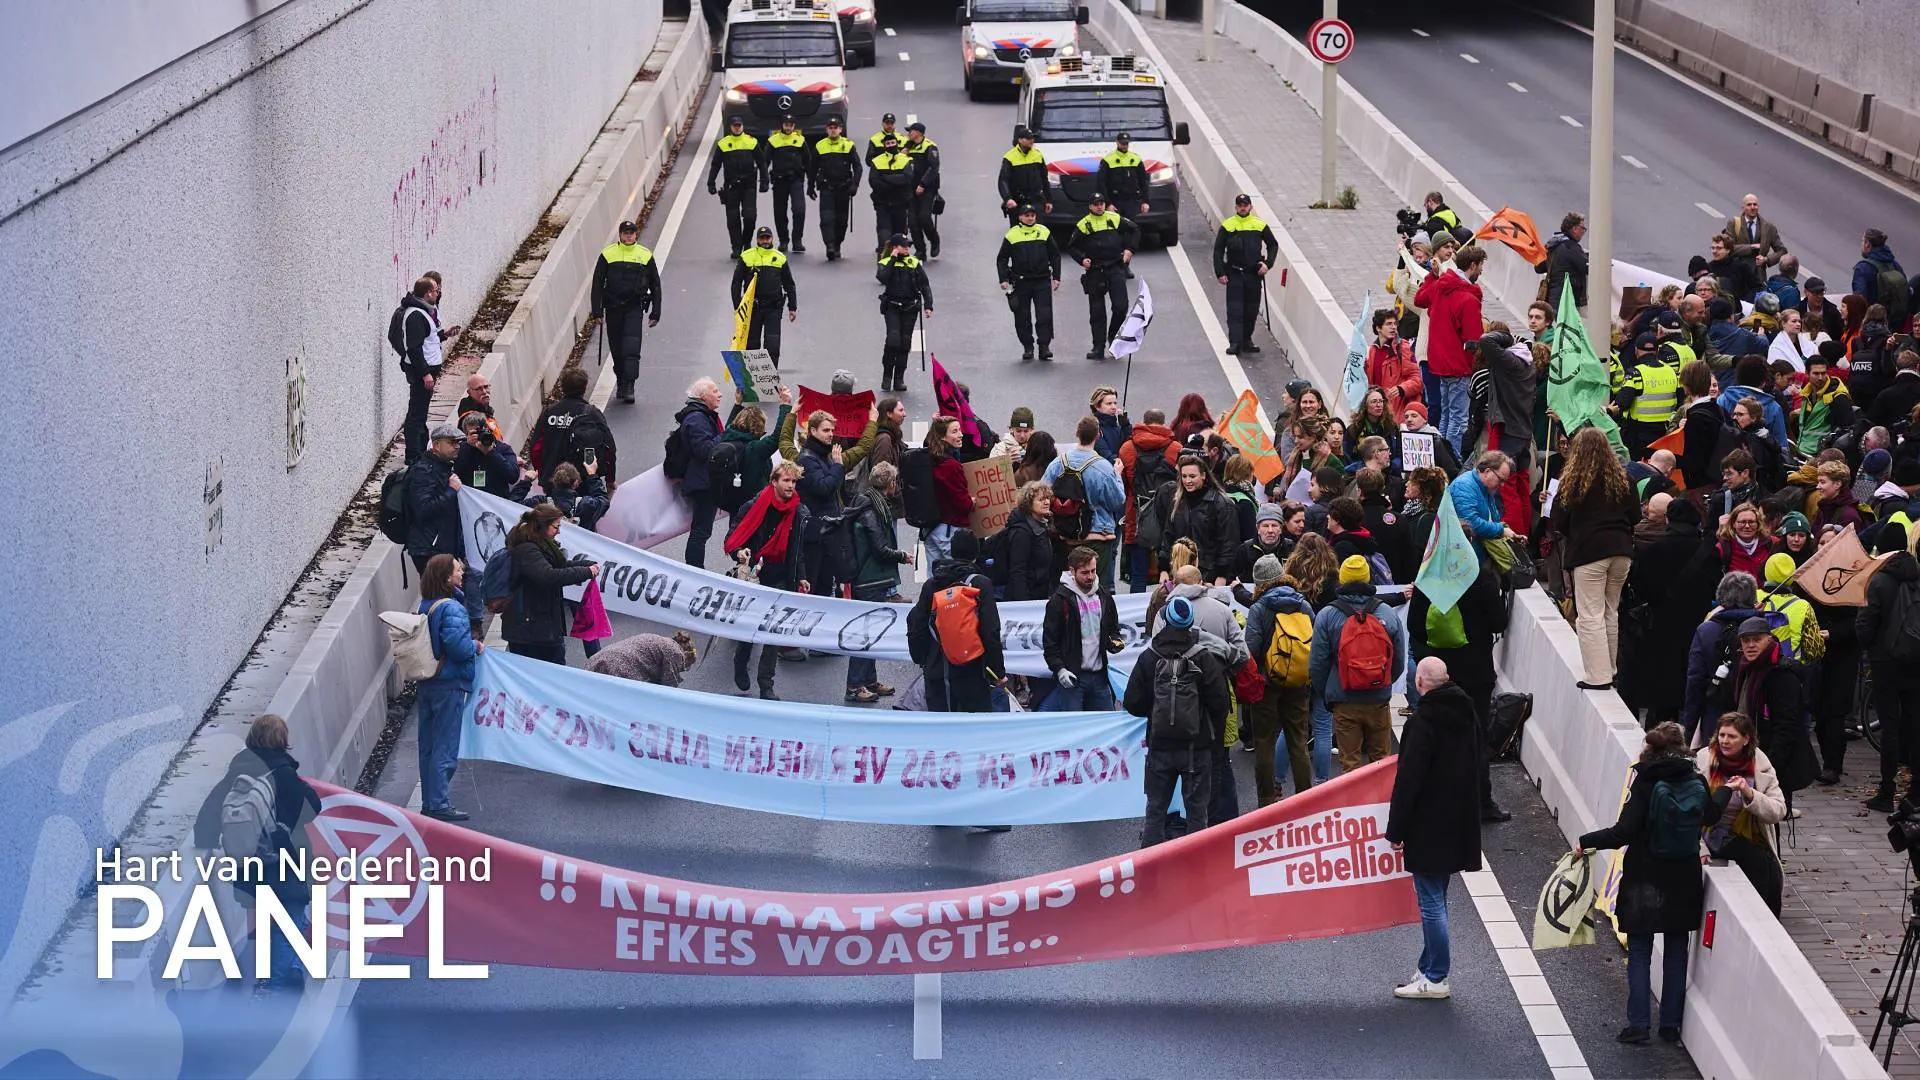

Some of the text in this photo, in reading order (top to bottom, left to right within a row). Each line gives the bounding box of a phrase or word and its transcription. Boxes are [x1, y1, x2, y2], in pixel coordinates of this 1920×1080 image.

[1320, 33, 1346, 49] 70
[1851, 361, 1873, 372] VANS
[974, 464, 1004, 486] niet
[1242, 810, 1378, 857] extinction
[600, 872, 1076, 931] KLIMAATCRISIS
[616, 916, 1059, 966] EFKES WOAGTE...
